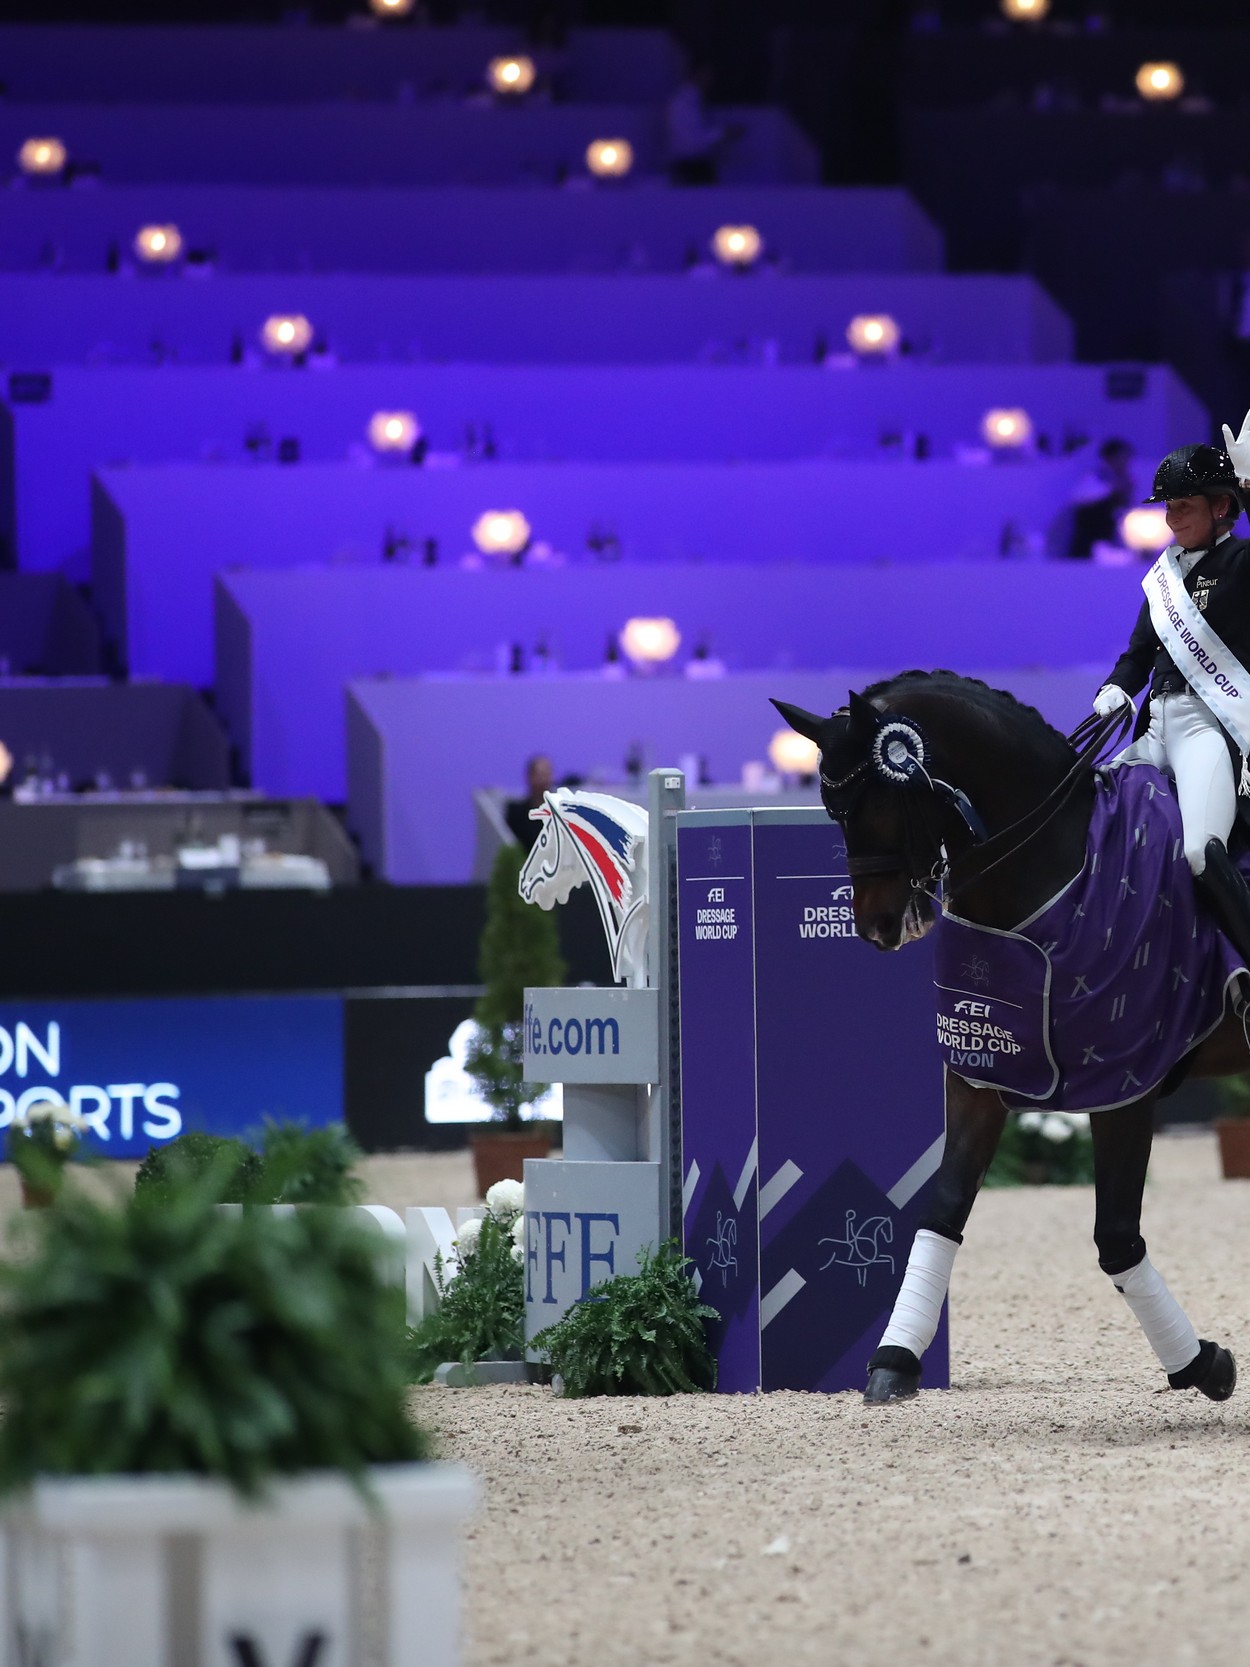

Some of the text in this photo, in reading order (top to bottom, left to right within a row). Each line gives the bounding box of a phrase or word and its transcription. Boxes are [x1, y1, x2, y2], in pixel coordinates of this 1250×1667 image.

[1156, 572, 1185, 631] DRESSAGE
[1180, 627, 1218, 675] WORLD
[1214, 673, 1239, 699] CUP
[707, 887, 725, 902] FEI
[696, 908, 735, 924] DRESSAGE
[695, 924, 738, 940] WORLD CUP
[953, 1000, 992, 1018] FEI
[936, 1012, 1016, 1043] DRESSAGE
[0, 1020, 60, 1078] N
[987, 1038, 1022, 1056] CUP
[950, 1049, 995, 1068] LYON
[525, 1211, 620, 1304] FFE
